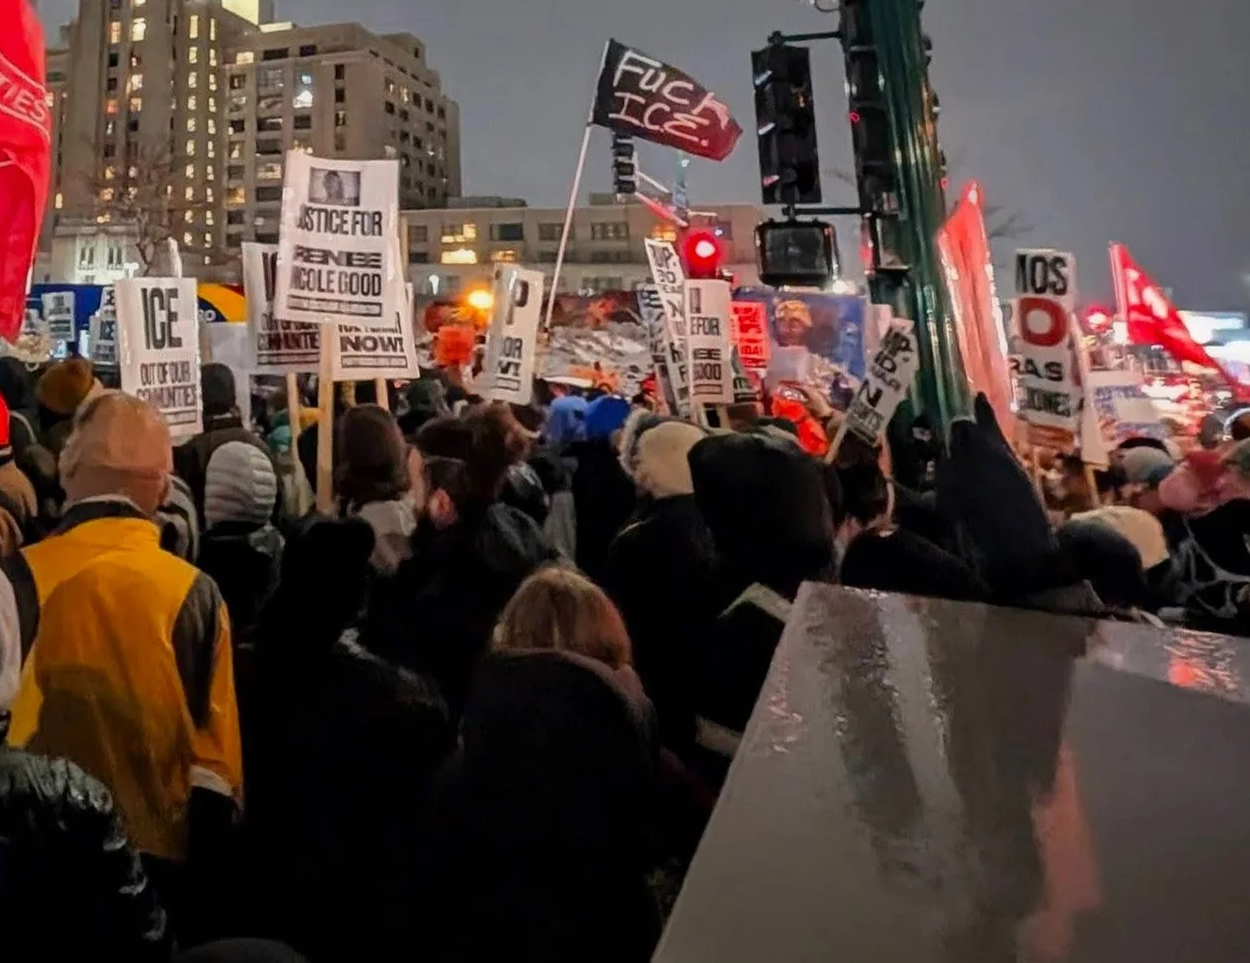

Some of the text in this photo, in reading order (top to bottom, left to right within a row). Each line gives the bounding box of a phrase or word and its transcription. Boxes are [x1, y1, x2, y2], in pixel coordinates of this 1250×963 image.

[351, 210, 383, 236] FOR
[338, 271, 382, 296] GOOD
[141, 287, 183, 350] ICE
[340, 335, 405, 353] NOW!
